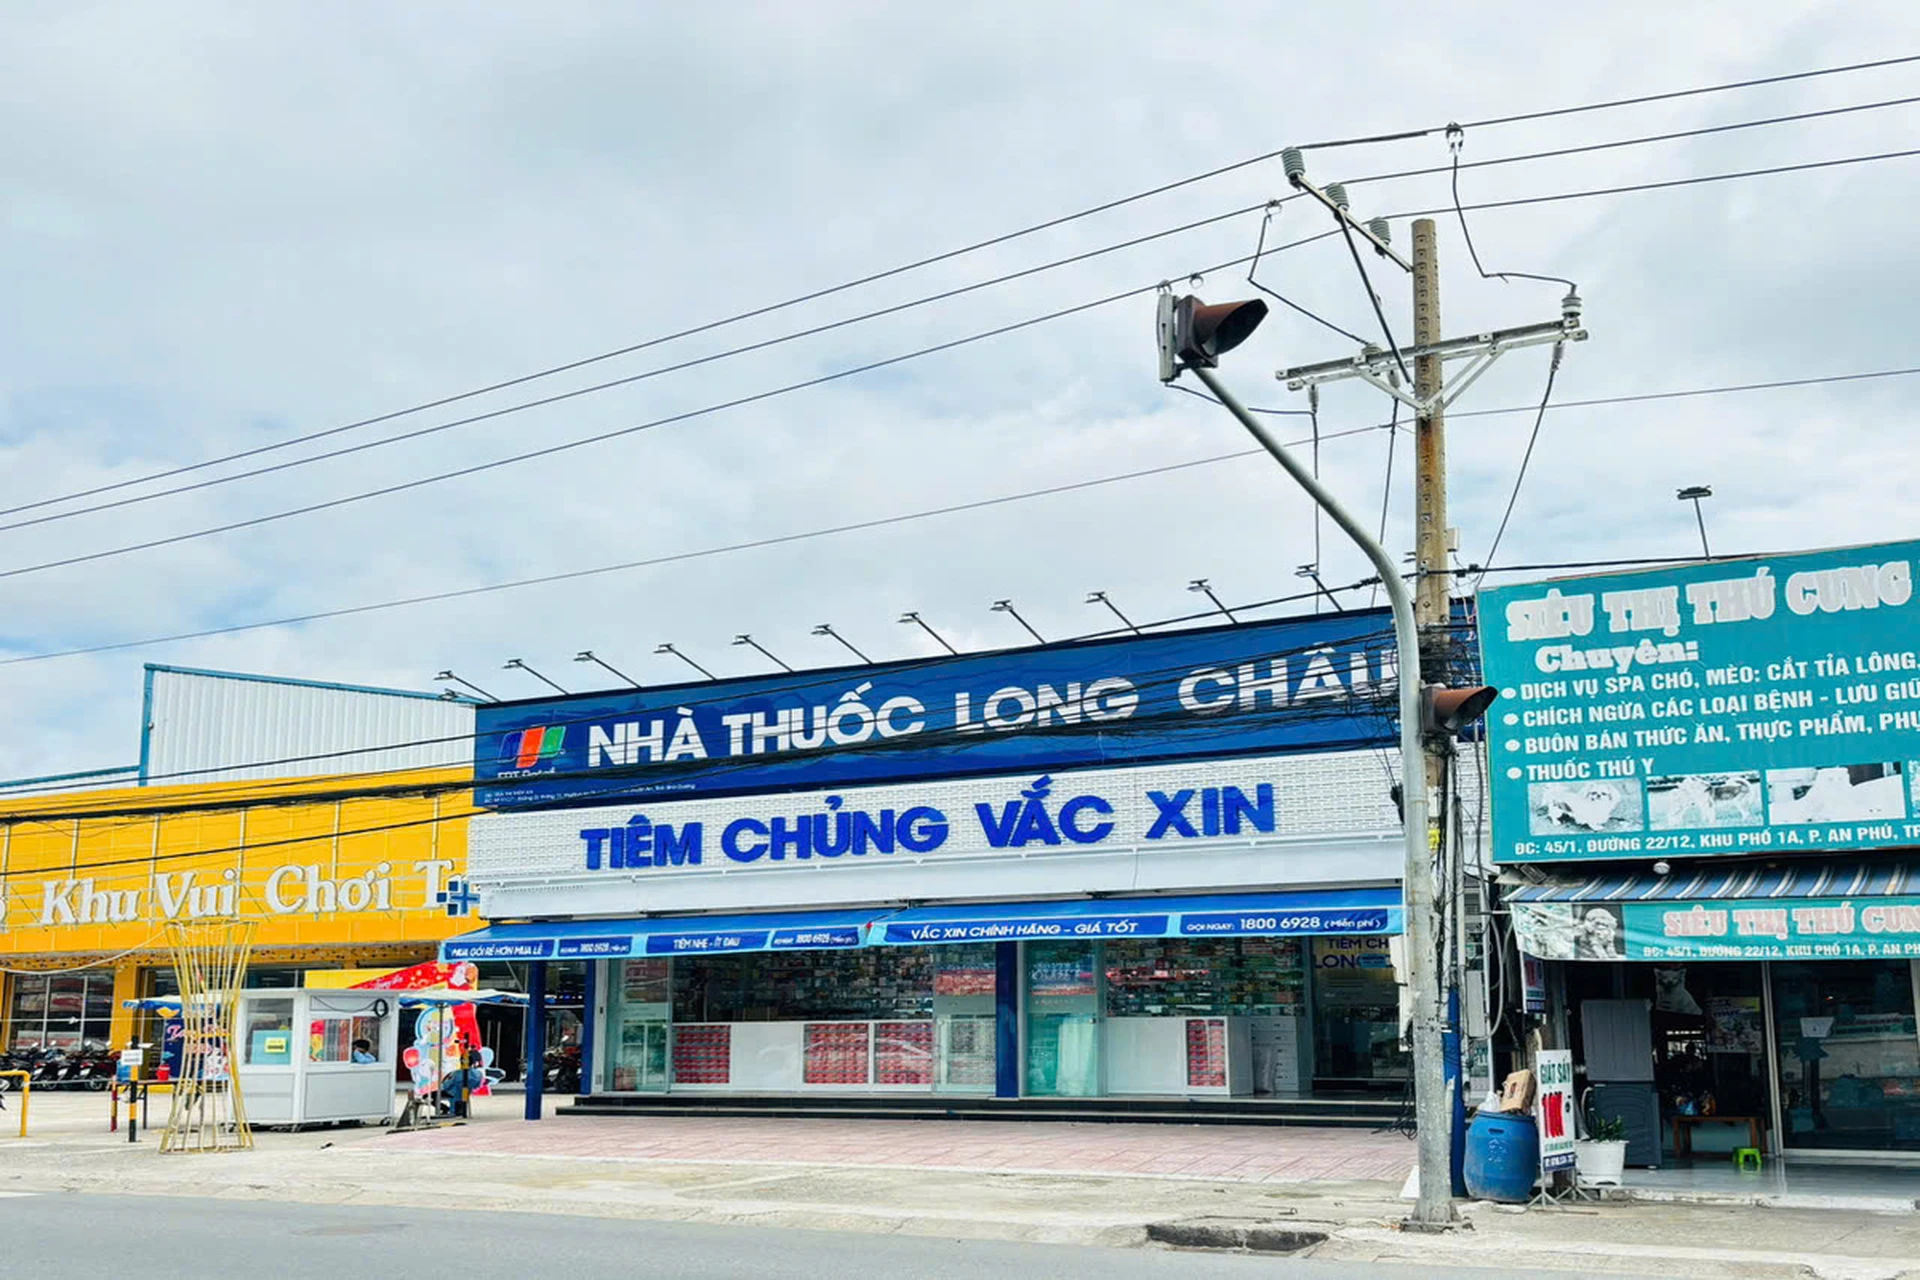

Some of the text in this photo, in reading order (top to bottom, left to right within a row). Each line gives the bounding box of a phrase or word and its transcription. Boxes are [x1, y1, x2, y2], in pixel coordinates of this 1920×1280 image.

[1506, 560, 1912, 642] SIÊU THỊ THÚ CUNG
[1534, 639, 1699, 674] Chuyên:
[1521, 681, 1567, 703] DỊCH
[1572, 678, 1599, 698] VỤ
[1605, 676, 1645, 694] SPA
[1651, 669, 1700, 690] CHÓ,
[1706, 666, 1760, 686] MÈO:
[1766, 656, 1808, 681] CẮT
[1814, 652, 1850, 677] TỈA
[588, 707, 708, 767] NHÀ
[722, 681, 926, 757] THUỐC
[955, 677, 1139, 733] LONG
[1523, 705, 1583, 727] CHÍCH
[1588, 701, 1645, 722] NGỪA
[1651, 697, 1693, 718] CÁC
[1701, 694, 1748, 716] LOẠI
[1754, 688, 1813, 715] BỆNH
[1835, 683, 1878, 704] LƯU
[1525, 733, 1579, 754] BUÔN
[1585, 730, 1628, 750] BÁN
[1633, 726, 1687, 747] THỨC
[1694, 722, 1731, 744] ĂN,
[1736, 720, 1792, 743] THỰC
[1799, 710, 1872, 737] PHẨM,
[1527, 756, 1655, 781] THUỐC THÚ Y
[581, 774, 1276, 870] TIÊM CHỦNG VẮC XIN
[1586, 836, 1641, 852] ĐƯỜNG
[1700, 833, 1733, 848] KHU
[1738, 827, 1772, 846] PHỐ
[1808, 830, 1822, 843] P.
[1828, 828, 1853, 842] AN
[40, 877, 140, 926] Khu
[155, 869, 238, 919] Vui
[265, 861, 392, 914] Chơi
[911, 925, 940, 940] VẮC
[943, 927, 966, 938] XIN
[969, 923, 1014, 937] CHÍNH
[1074, 920, 1101, 933] GIÁ
[1106, 919, 1138, 933] TỐT
[1240, 917, 1277, 930] 1800
[1280, 916, 1320, 928] 6928
[1663, 904, 1728, 936] SIÊU
[1732, 908, 1788, 940] THỊ
[1791, 901, 1855, 934] THÚ
[1785, 945, 1812, 956] KHU
[1882, 943, 1901, 955] AN
